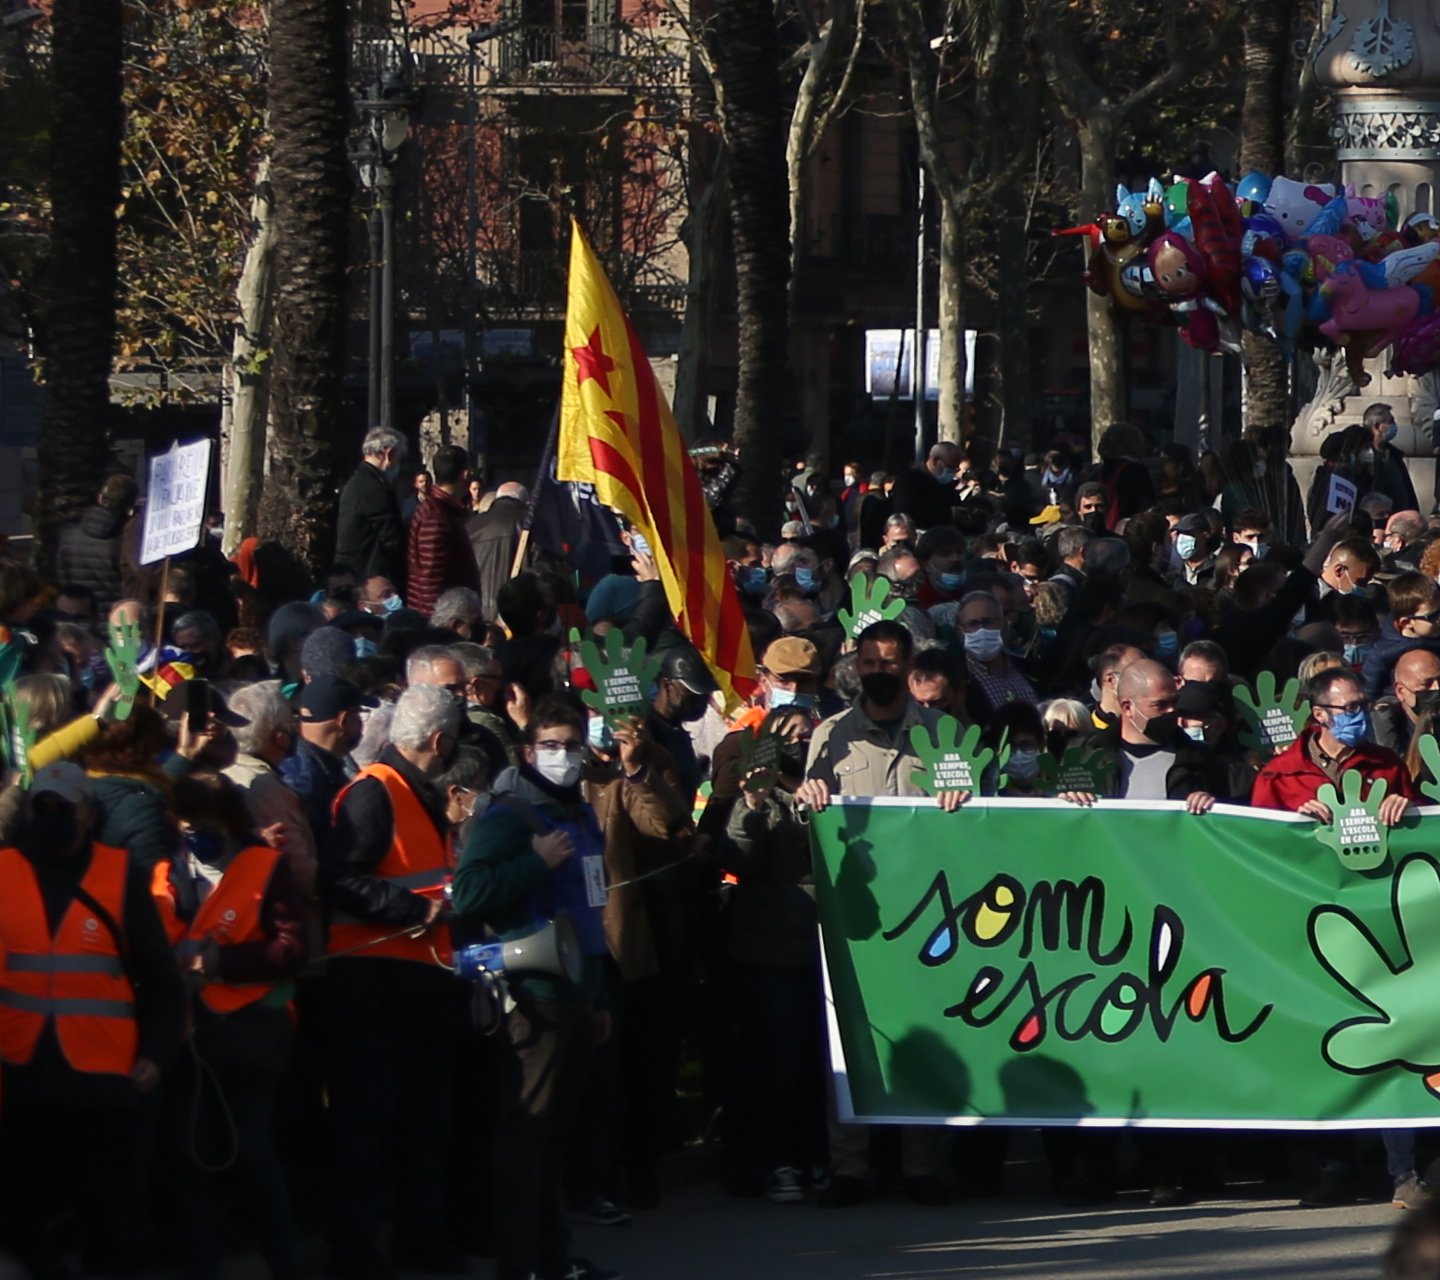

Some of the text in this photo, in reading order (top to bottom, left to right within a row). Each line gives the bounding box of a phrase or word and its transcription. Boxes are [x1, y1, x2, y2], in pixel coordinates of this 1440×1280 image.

[607, 686, 638, 695] L'ESCOLA
[605, 695, 617, 704] EN
[935, 780, 946, 788] EN
[1343, 826, 1376, 834] L'ESCOLA
[1341, 835, 1351, 843] EN
[883, 870, 1134, 967] som
[943, 903, 1275, 1054] escola
